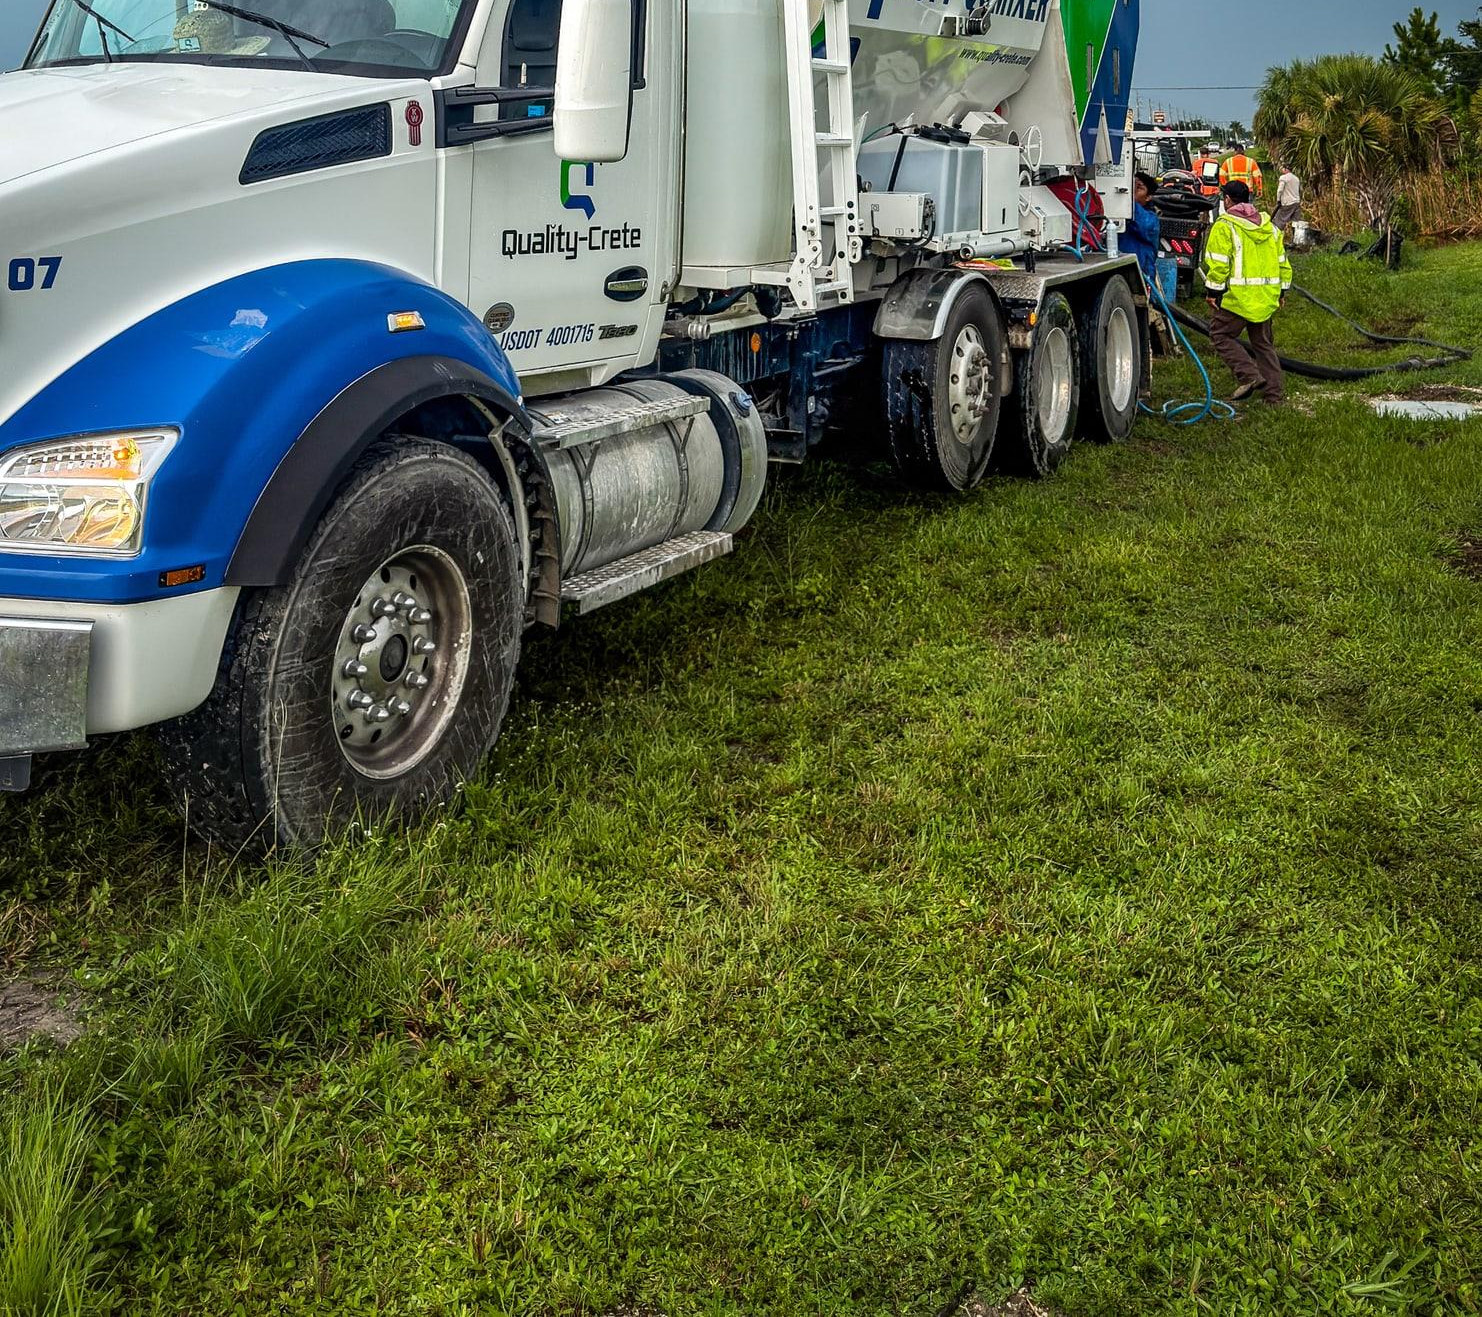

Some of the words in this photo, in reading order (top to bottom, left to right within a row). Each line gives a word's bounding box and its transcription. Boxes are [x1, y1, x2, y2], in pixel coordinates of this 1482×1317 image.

[502, 221, 641, 260] Quality-Crete
[8, 256, 63, 291] 07
[501, 329, 543, 351] USDOT
[546, 323, 595, 347] 4001715
